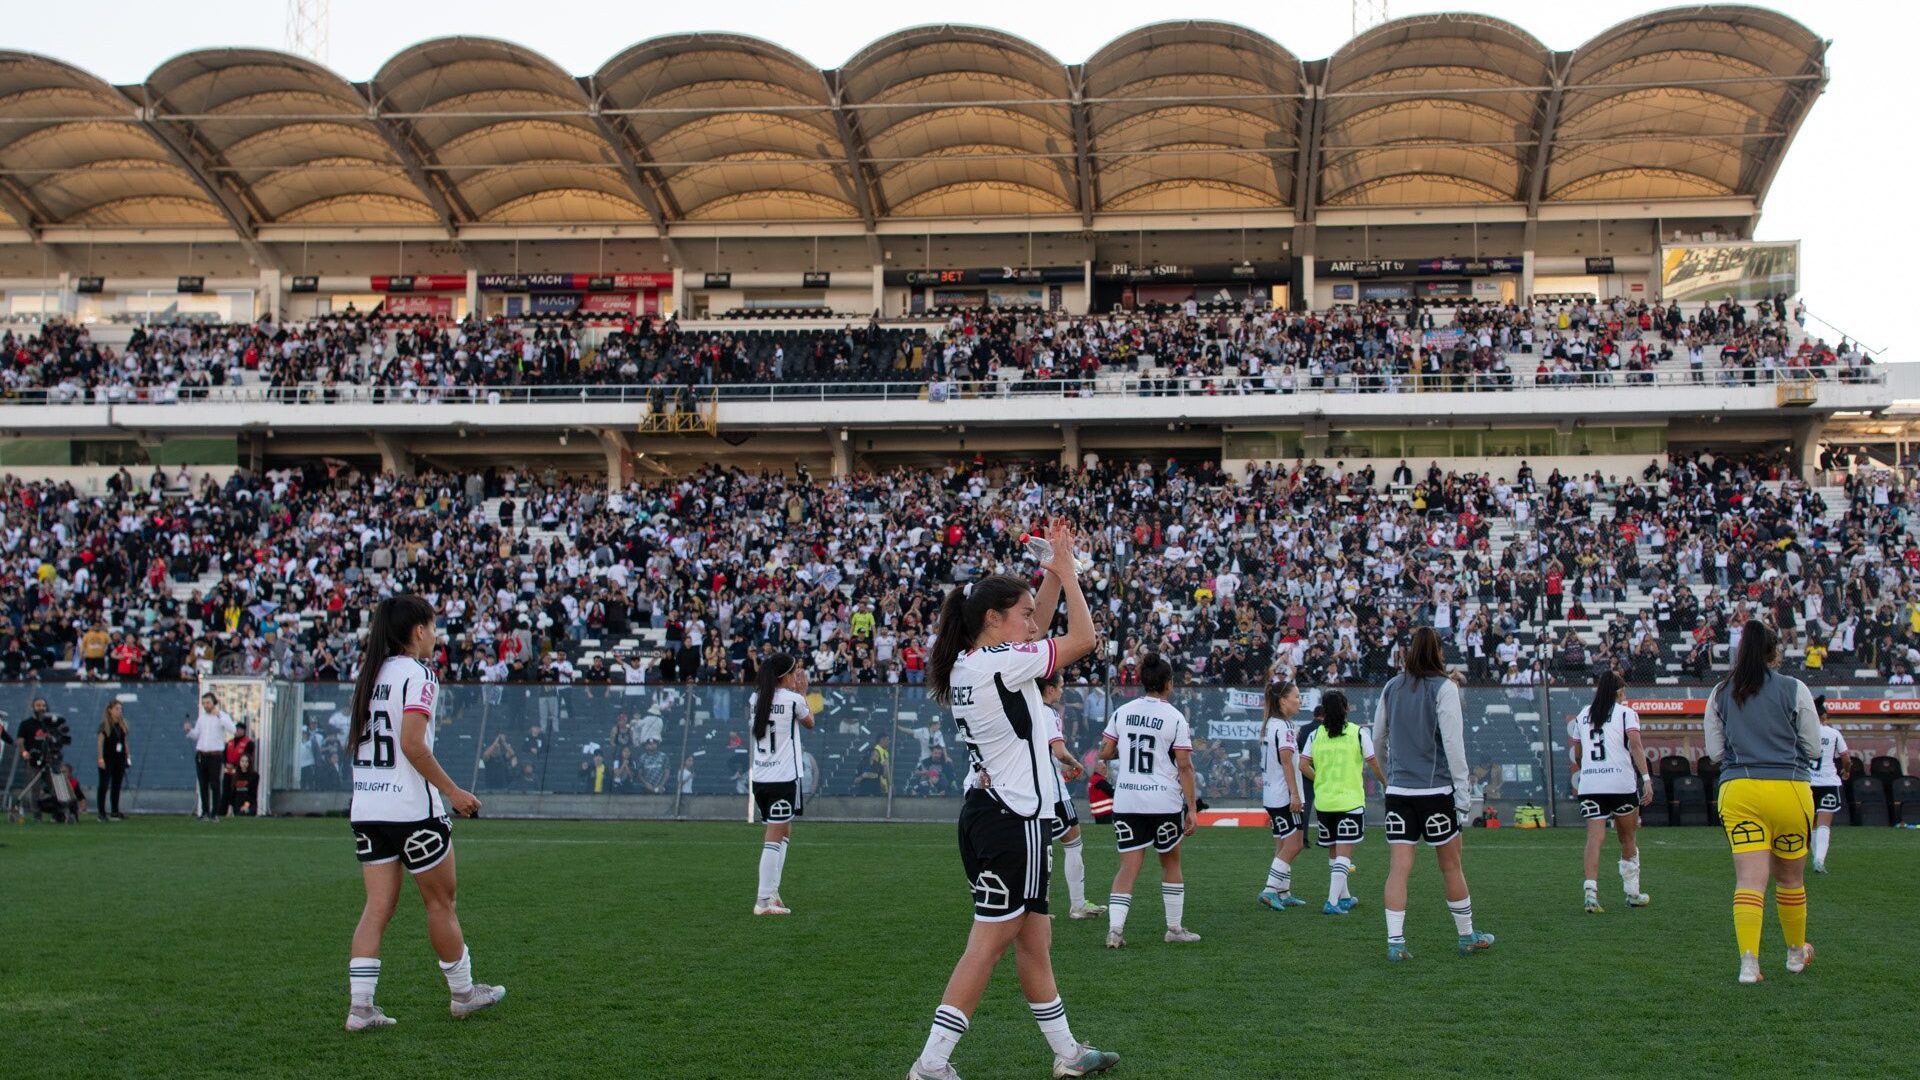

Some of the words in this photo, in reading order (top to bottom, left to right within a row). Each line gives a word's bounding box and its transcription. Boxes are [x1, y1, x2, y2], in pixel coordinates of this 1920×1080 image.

[1330, 261, 1392, 272] AMBHT
[485, 275, 513, 286] MAC
[528, 274, 562, 285] MACH
[539, 296, 576, 305] MACH
[1631, 700, 1684, 711] GATORADE
[1823, 701, 1861, 710] TORADE
[1879, 700, 1891, 712] G
[1125, 714, 1164, 731] HIDALGO
[353, 710, 397, 769] 26
[1589, 728, 1607, 762] 3
[1127, 732, 1156, 775] 16
[392, 784, 403, 793] tv
[1119, 783, 1159, 792] AMBILIGHT
